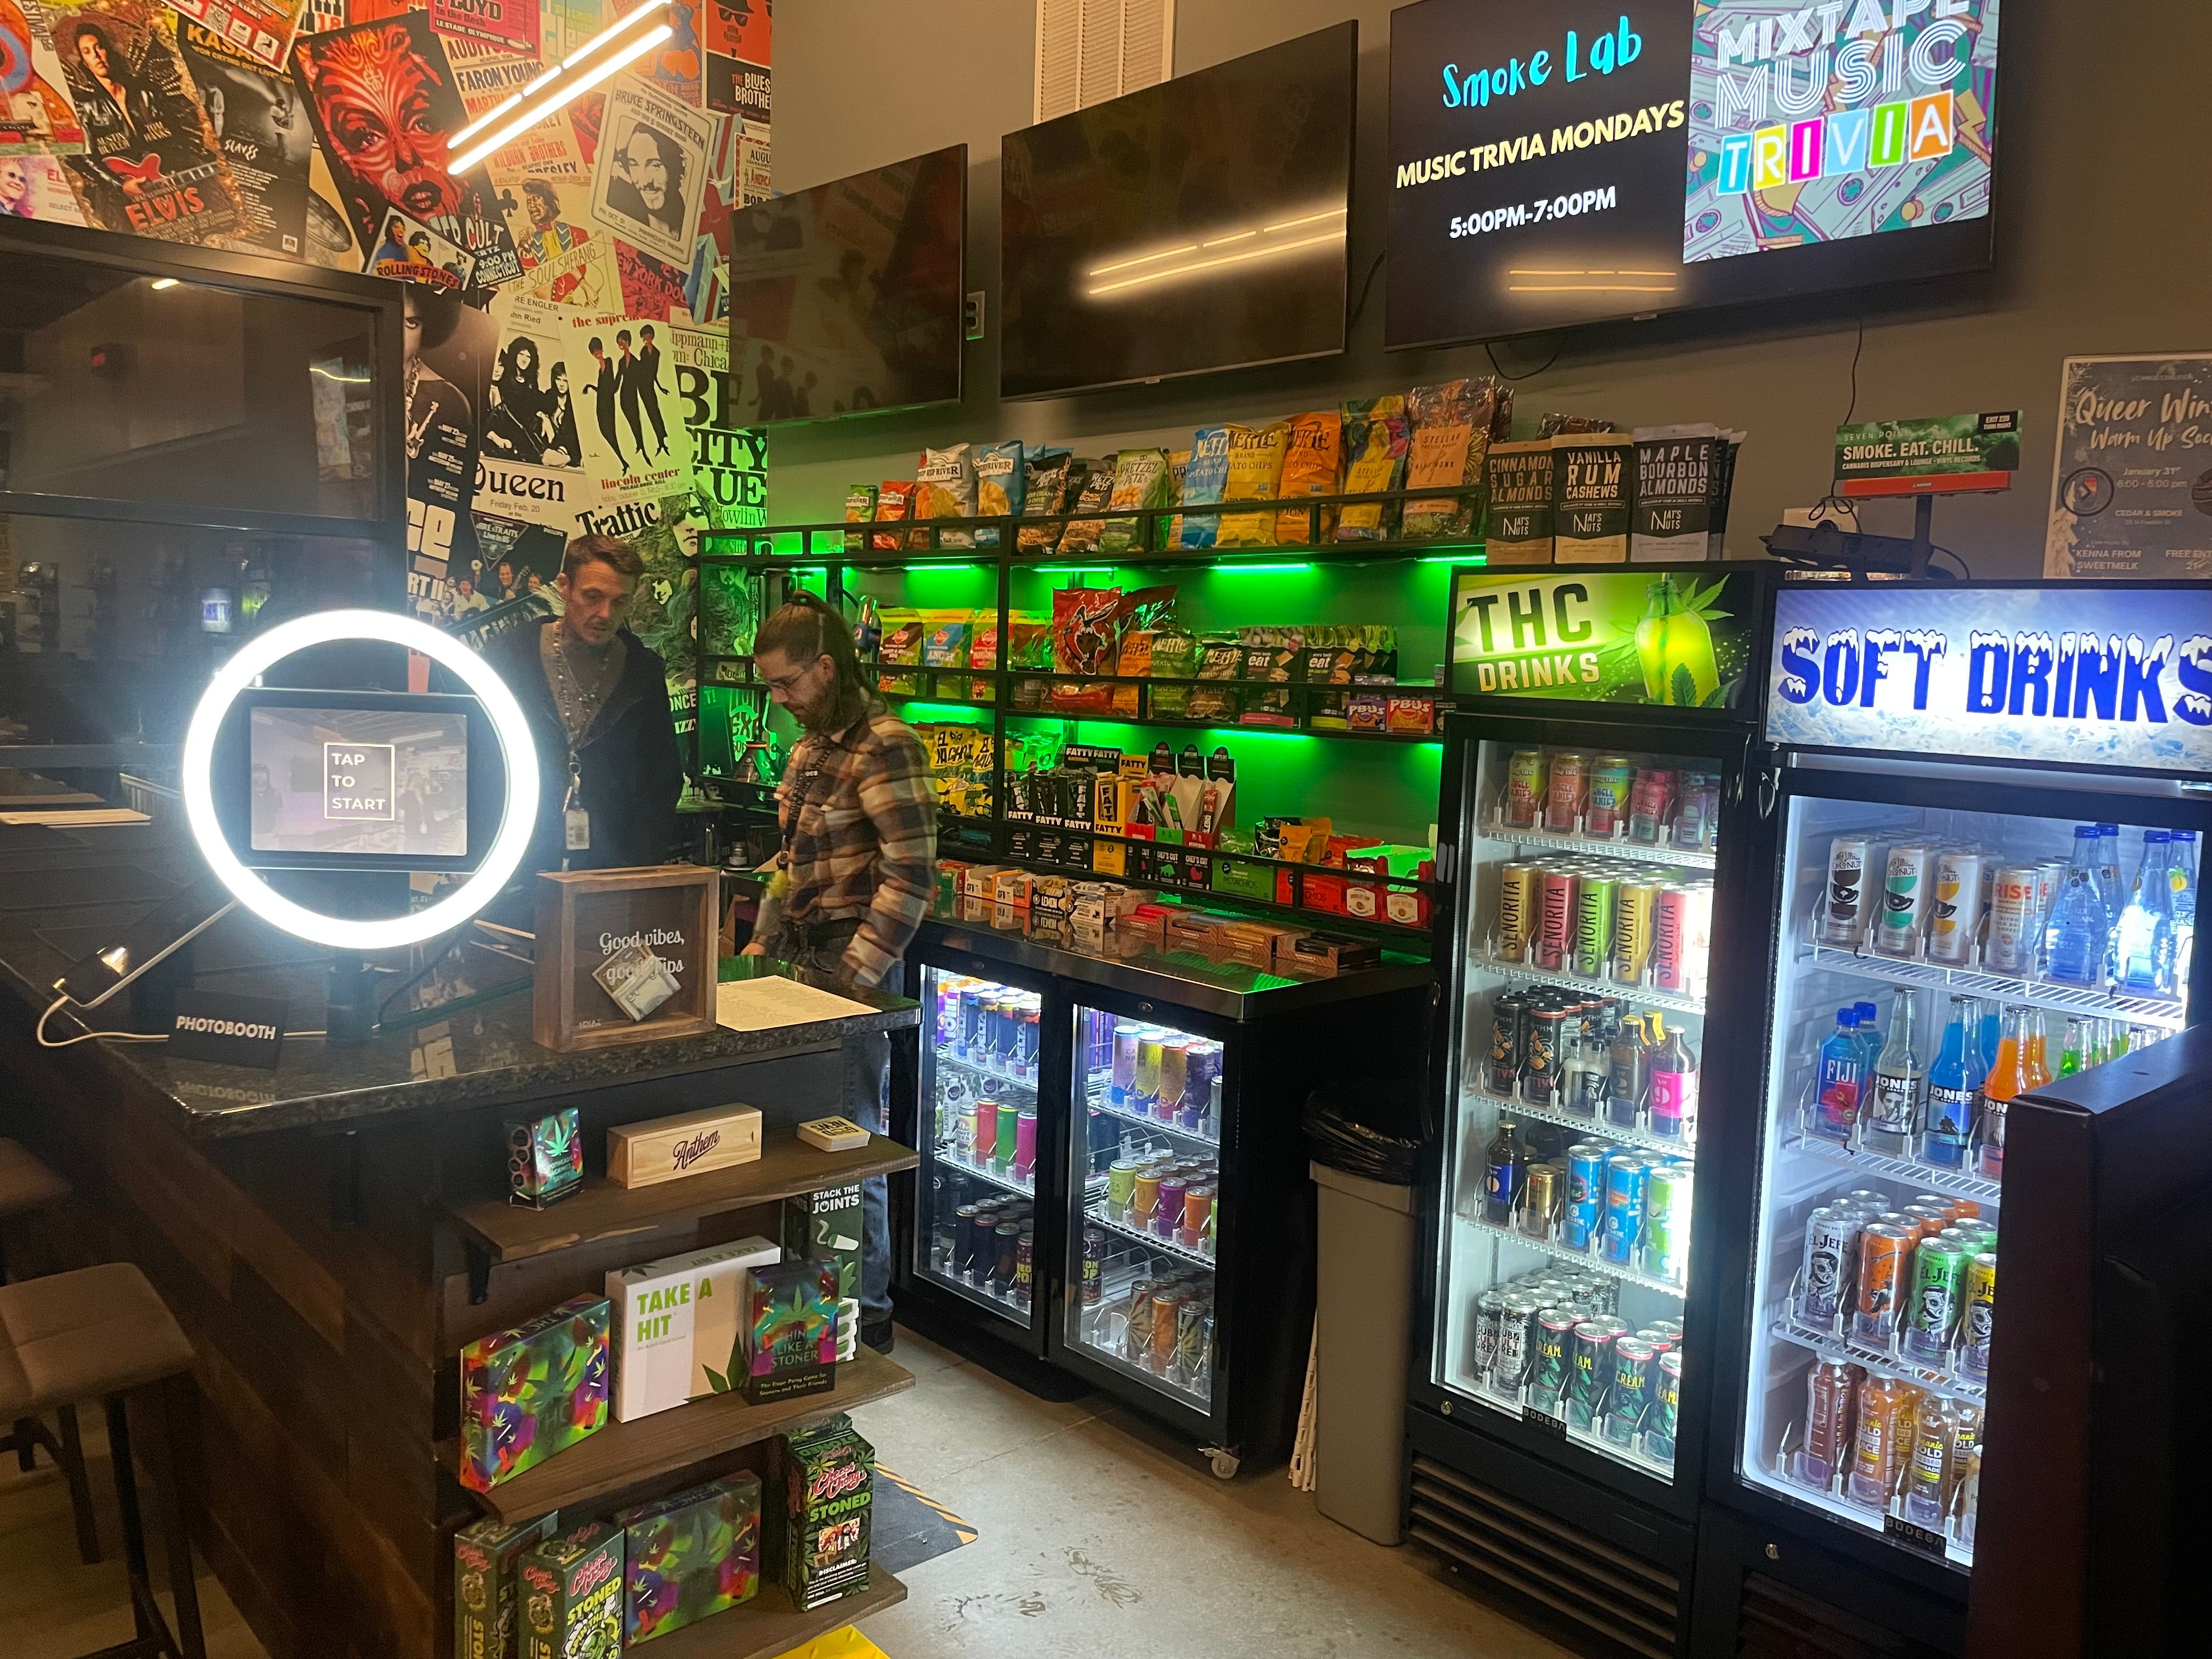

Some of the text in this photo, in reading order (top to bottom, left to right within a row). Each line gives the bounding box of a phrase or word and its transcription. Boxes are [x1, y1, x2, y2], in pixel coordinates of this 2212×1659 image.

[445, 22, 466, 34] STADE
[468, 28, 505, 44] OLYMPIQUE
[1442, 15, 1643, 108] Smoke Lab
[456, 61, 545, 92] FARON YOUNG
[732, 72, 770, 94] THE BLUES
[1715, 19, 1967, 129] MUSIC
[616, 90, 642, 108] BRUCE
[645, 100, 704, 152] SPRINGSTEEN
[224, 138, 258, 161] SLAVES
[529, 140, 567, 162] BROTHERS
[1396, 100, 1685, 189] MUSIC TRIVIA MONDAYS
[1722, 102, 1949, 189] TRIVIA
[125, 187, 204, 231] ELVIS
[1449, 185, 1616, 239] 5:00PM-7:00PM
[465, 217, 504, 250] CULT
[478, 250, 516, 267] 9:00 PM
[528, 262, 556, 289] SOUL
[557, 243, 596, 271] SHEBANG
[376, 263, 460, 289] ROLLING STONES
[527, 297, 558, 312] ENGLER
[524, 313, 541, 324] Ried
[572, 316, 592, 328] the
[2075, 386, 2153, 426] Queer
[1843, 432, 1874, 442] SEVEN
[2090, 426, 2174, 452] Warm Up
[1567, 450, 1622, 465] VANILLA
[1639, 444, 1710, 464] MAPLE
[1843, 437, 1979, 461] SMOKE. EAT. CHILL.
[936, 465, 959, 476] RIVER
[987, 461, 1011, 471] RIVER
[1120, 462, 1158, 475] PRETZEL
[1248, 461, 1273, 470] CHIPS
[1842, 460, 1870, 470] CANNABIS
[1870, 459, 1905, 469] DISPENSARY
[1910, 458, 1933, 466] LOUNGE
[1954, 454, 1981, 463] RECORDS
[601, 468, 680, 490] lincoln center
[1490, 471, 1553, 488] SUGAR
[1567, 462, 1622, 486] RUM
[1639, 462, 1708, 481] BOURBON
[2123, 467, 2163, 477] January
[1566, 484, 1619, 500] CASHEWS
[1639, 477, 1707, 498] ALMONDS
[2117, 478, 2139, 488] 6:00
[2171, 481, 2188, 489] pm
[1491, 485, 1553, 503] ALMONDS
[490, 499, 540, 513] Friday Feb. 20
[2076, 550, 2142, 558] KENNA FROM
[2165, 550, 2192, 558] FREE
[2076, 562, 2138, 570] SWEETMELK
[1466, 582, 1592, 653] THC
[1248, 656, 1271, 668] eat
[1308, 656, 1331, 668] eat
[1477, 652, 1600, 692] DRINKS
[1778, 625, 2212, 726] SOFT DRINKS
[331, 752, 366, 766] TAP
[1066, 747, 1093, 757] FATTY
[1093, 749, 1119, 759] FATTY
[1121, 759, 1147, 769] FATTY
[331, 774, 356, 788] TO
[331, 797, 386, 811] START
[1008, 811, 1034, 821] FATTY
[1035, 815, 1062, 828] FATTY
[1064, 819, 1092, 830] FATTY
[1095, 823, 1122, 833] FATTY
[1156, 850, 1179, 861] CHEF'S CUT
[1185, 854, 1209, 866] CHEF'S CUT
[1223, 876, 1258, 890] PISTACHIOS
[1994, 882, 2032, 900] RISE
[599, 928, 685, 955] Good vibes,
[176, 1015, 276, 1040] PHOTOBOOTH
[1826, 1058, 1857, 1084] FIJI
[1874, 1074, 1917, 1091] JONES
[1929, 1085, 1973, 1102] JONES
[1983, 1098, 2008, 1114] JON
[673, 1129, 721, 1171] Anthem
[812, 1184, 860, 1201] STACK THE
[812, 1194, 860, 1215] JOINTS
[1820, 1233, 1848, 1253] JEFE
[1933, 1267, 1961, 1286] JEFE
[636, 1277, 713, 1316] TAKE A
[636, 1314, 673, 1343] HIT
[777, 1341, 814, 1355] LIKE A
[771, 1350, 819, 1369] STONER
[809, 1491, 871, 1523] STONED
[819, 1558, 857, 1577] DISCLAIMER:
[567, 1576, 622, 1627] STONED
